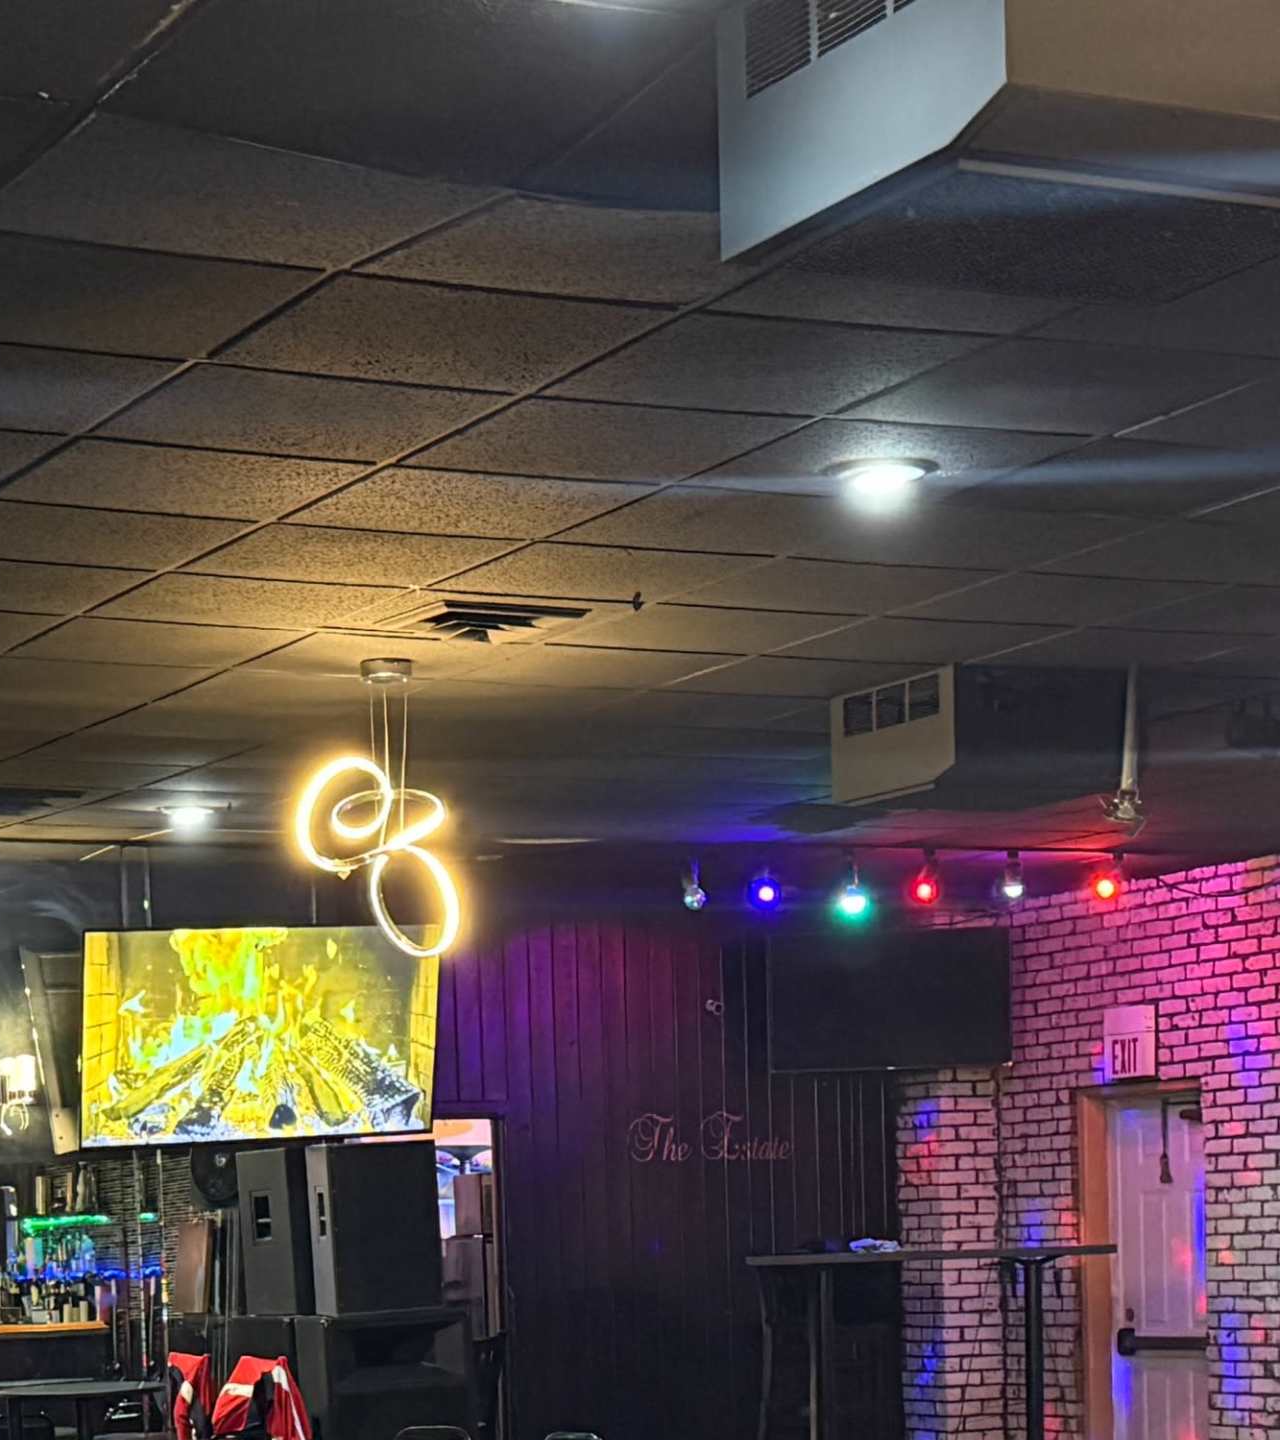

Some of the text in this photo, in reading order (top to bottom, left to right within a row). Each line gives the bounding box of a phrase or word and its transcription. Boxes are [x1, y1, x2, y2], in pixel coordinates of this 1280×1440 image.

[1112, 1037, 1138, 1075] EXIT
[628, 1111, 790, 1161] The Estate
